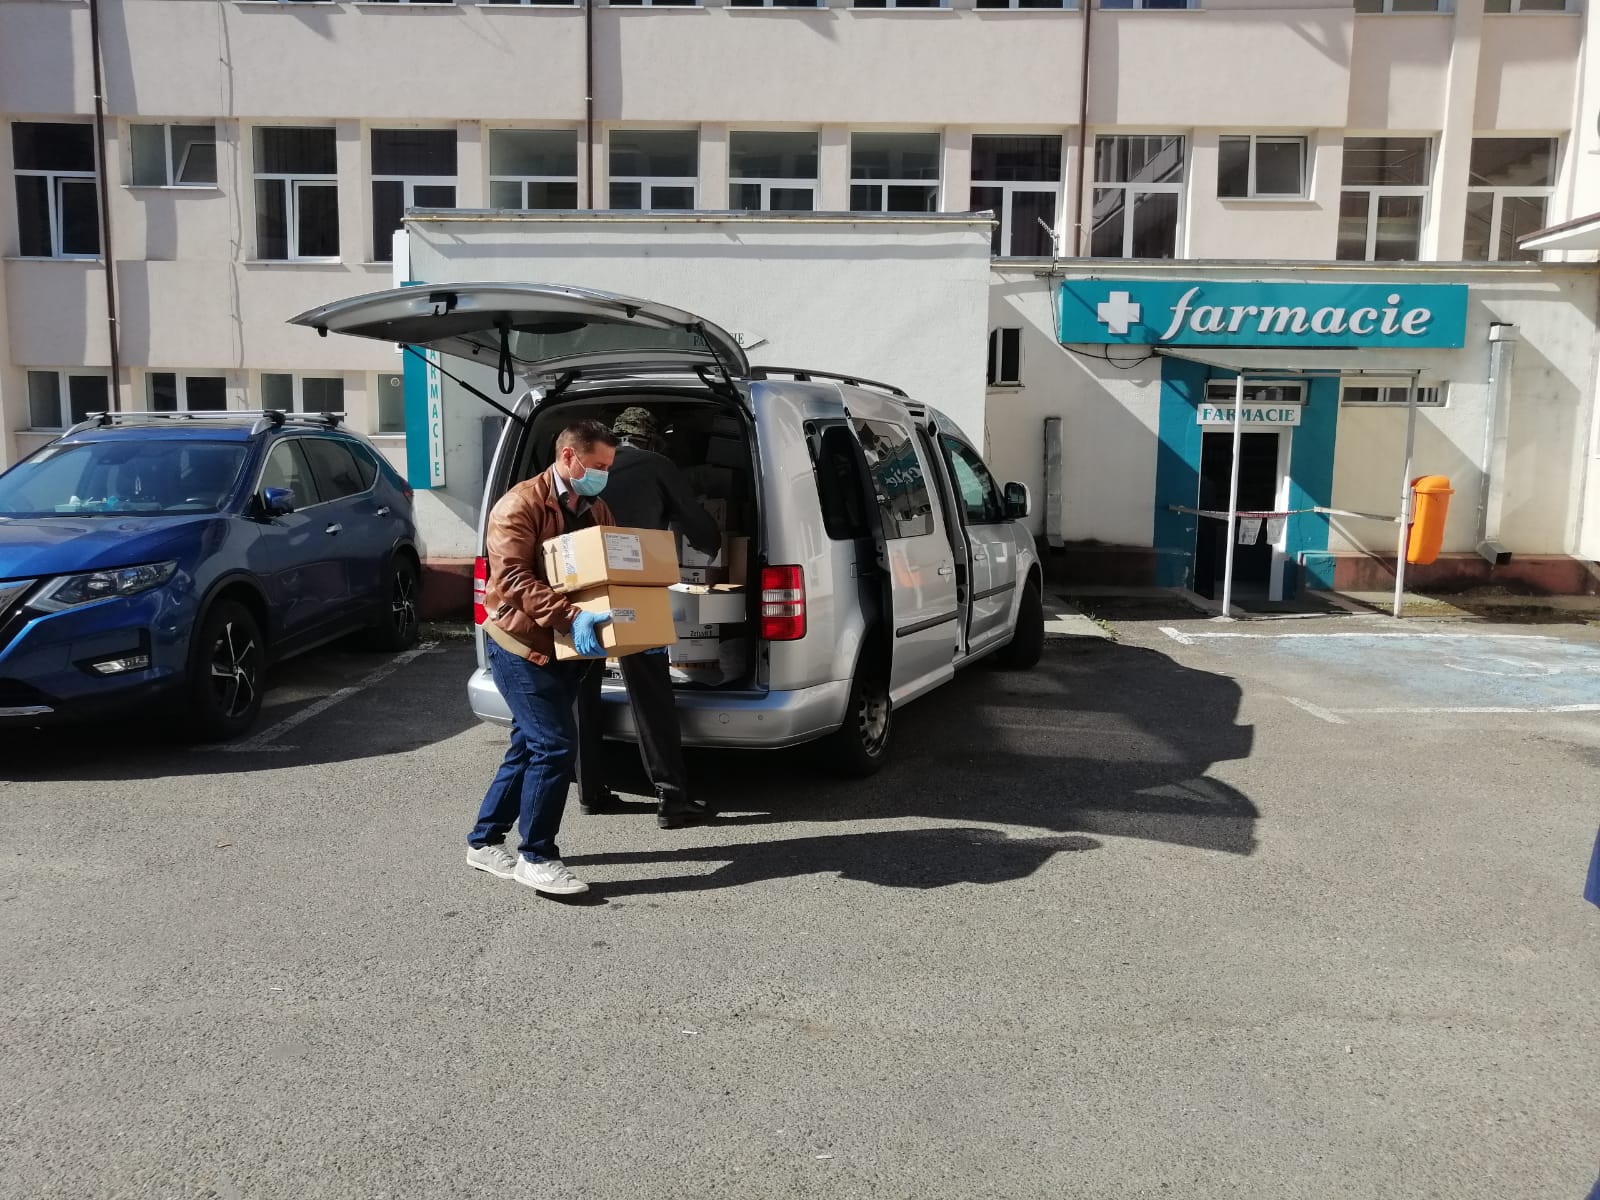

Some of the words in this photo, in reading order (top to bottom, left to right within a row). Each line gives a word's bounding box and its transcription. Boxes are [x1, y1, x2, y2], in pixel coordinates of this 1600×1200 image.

[1160, 287, 1431, 340] farmacie
[429, 347, 440, 477] ARMACIE
[1203, 408, 1295, 422] FARMACIE
